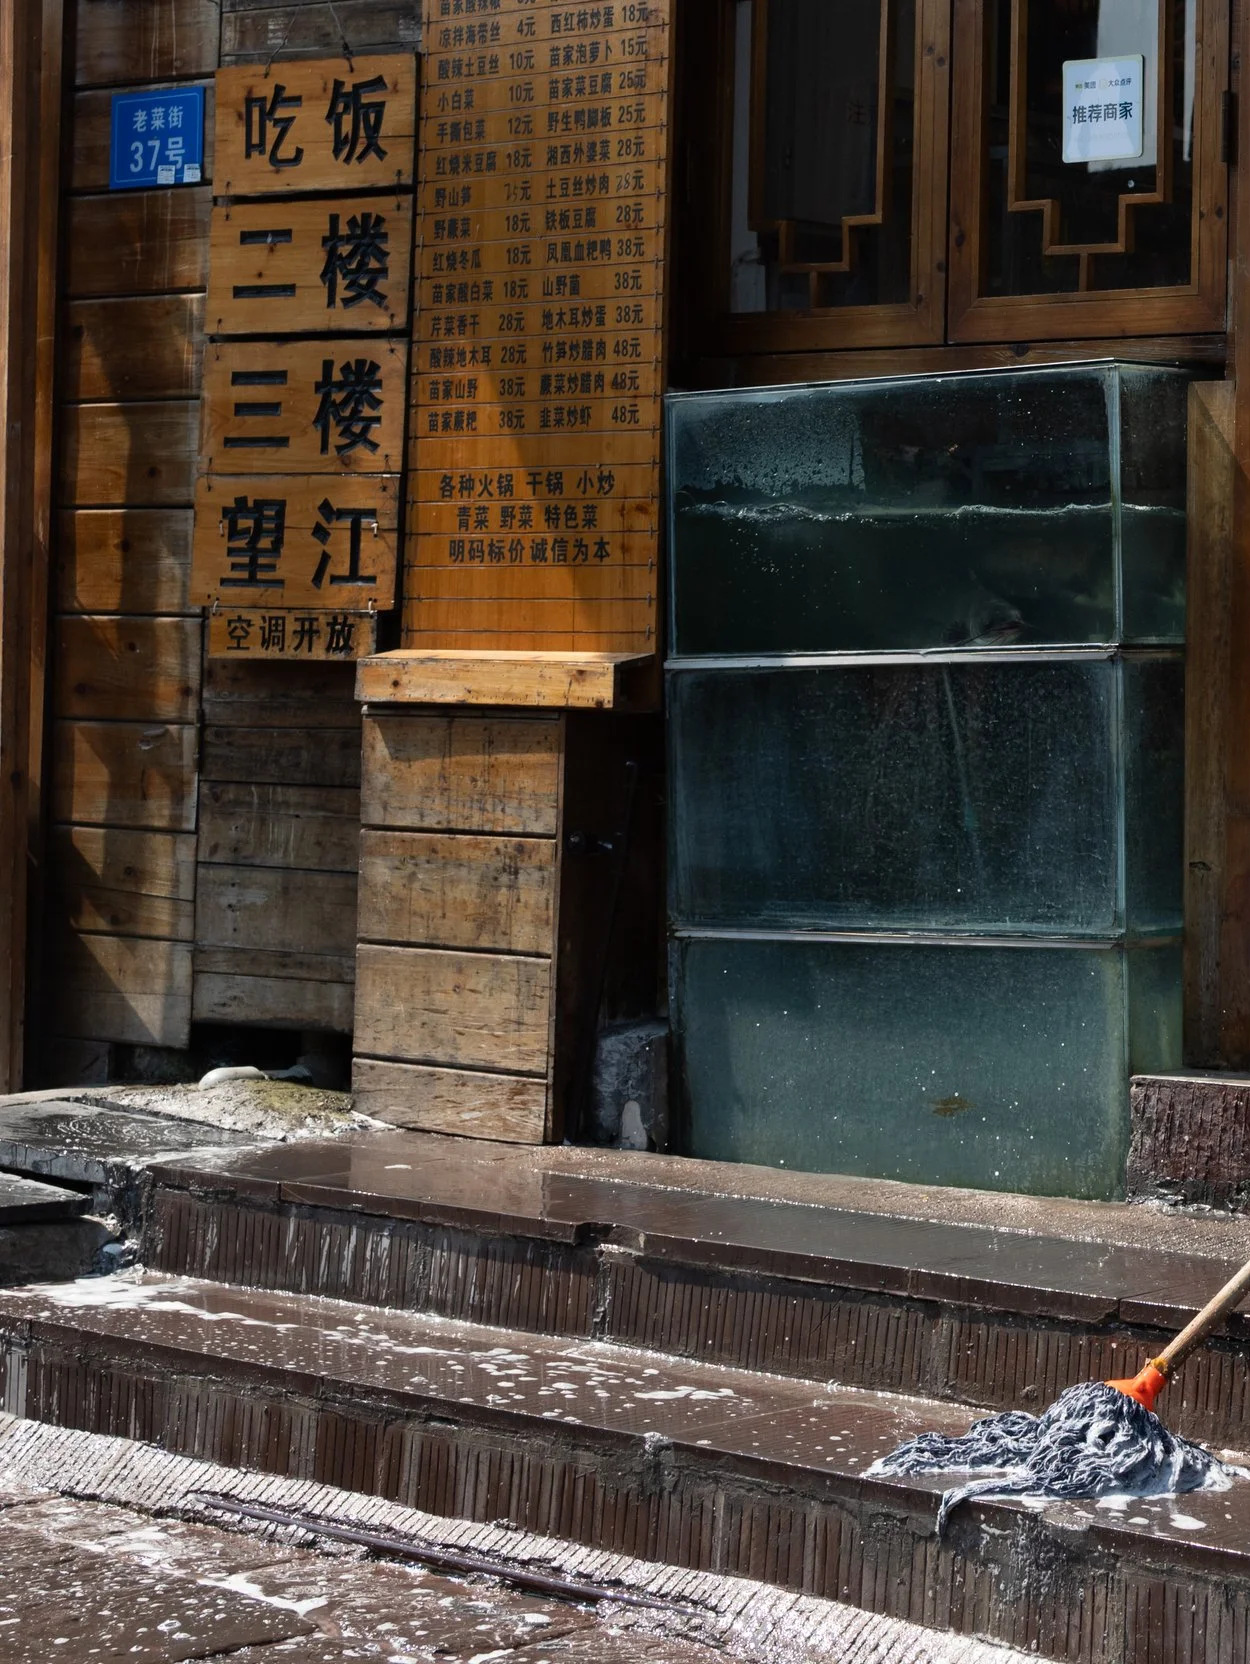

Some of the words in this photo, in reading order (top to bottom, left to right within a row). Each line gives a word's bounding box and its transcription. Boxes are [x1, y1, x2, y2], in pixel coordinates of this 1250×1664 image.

[516, 17, 536, 37] 4元
[551, 6, 615, 34] 西红柿炒蛋
[622, 2, 649, 23] 18元
[438, 53, 499, 80] 酸辣土豆丝
[509, 49, 535, 70] 10元
[549, 39, 613, 67] 苗家泡萝卜
[621, 35, 648, 57] 15元
[437, 88, 475, 112] 小白菜
[508, 82, 534, 103] 10元
[549, 72, 613, 100] 苗家菜豆腐
[619, 68, 646, 90] 25元
[132, 105, 184, 133] 老菜街
[244, 74, 389, 168] 吃饭
[507, 116, 533, 135] 12元
[618, 103, 646, 125] 25元
[1072, 101, 1133, 124] 推荐商家
[129, 137, 186, 173] 37号
[506, 148, 532, 169] 18元
[547, 139, 611, 167] 湘西外婆菜
[617, 135, 645, 157] 28元
[545, 171, 610, 199] 土豆丝炒肉
[505, 212, 531, 233] 18元
[545, 206, 597, 232] 铁板豆腐
[616, 202, 644, 224] 28元
[432, 248, 482, 273] 红烧冬瓜
[506, 245, 532, 265] 18元
[617, 236, 645, 258] 38元
[233, 212, 390, 310] 二楼
[432, 279, 494, 304] 苗家酸白菜
[503, 278, 528, 299] 18元
[615, 269, 642, 291] 38元
[430, 314, 480, 337] 芹菜香干
[498, 311, 525, 332] 28元
[541, 304, 607, 330] 地木耳炒蛋
[616, 303, 643, 324] 38元
[429, 345, 492, 369] 酸辣地木耳
[500, 343, 527, 365] 28元
[613, 337, 641, 358] 48元
[500, 376, 525, 397] 38元
[223, 358, 384, 456] 三楼
[499, 409, 525, 430] 38元
[539, 405, 592, 429] 韭菜炒虾
[612, 403, 640, 425] 48元
[439, 473, 514, 499] 各种火锅
[526, 471, 563, 496] 干锅
[576, 470, 615, 496] 小炒
[456, 506, 490, 531] 青菜
[499, 505, 534, 530] 野菜
[544, 504, 599, 530] 特色菜
[219, 495, 378, 590] 望江
[226, 615, 356, 654] 空调开放
